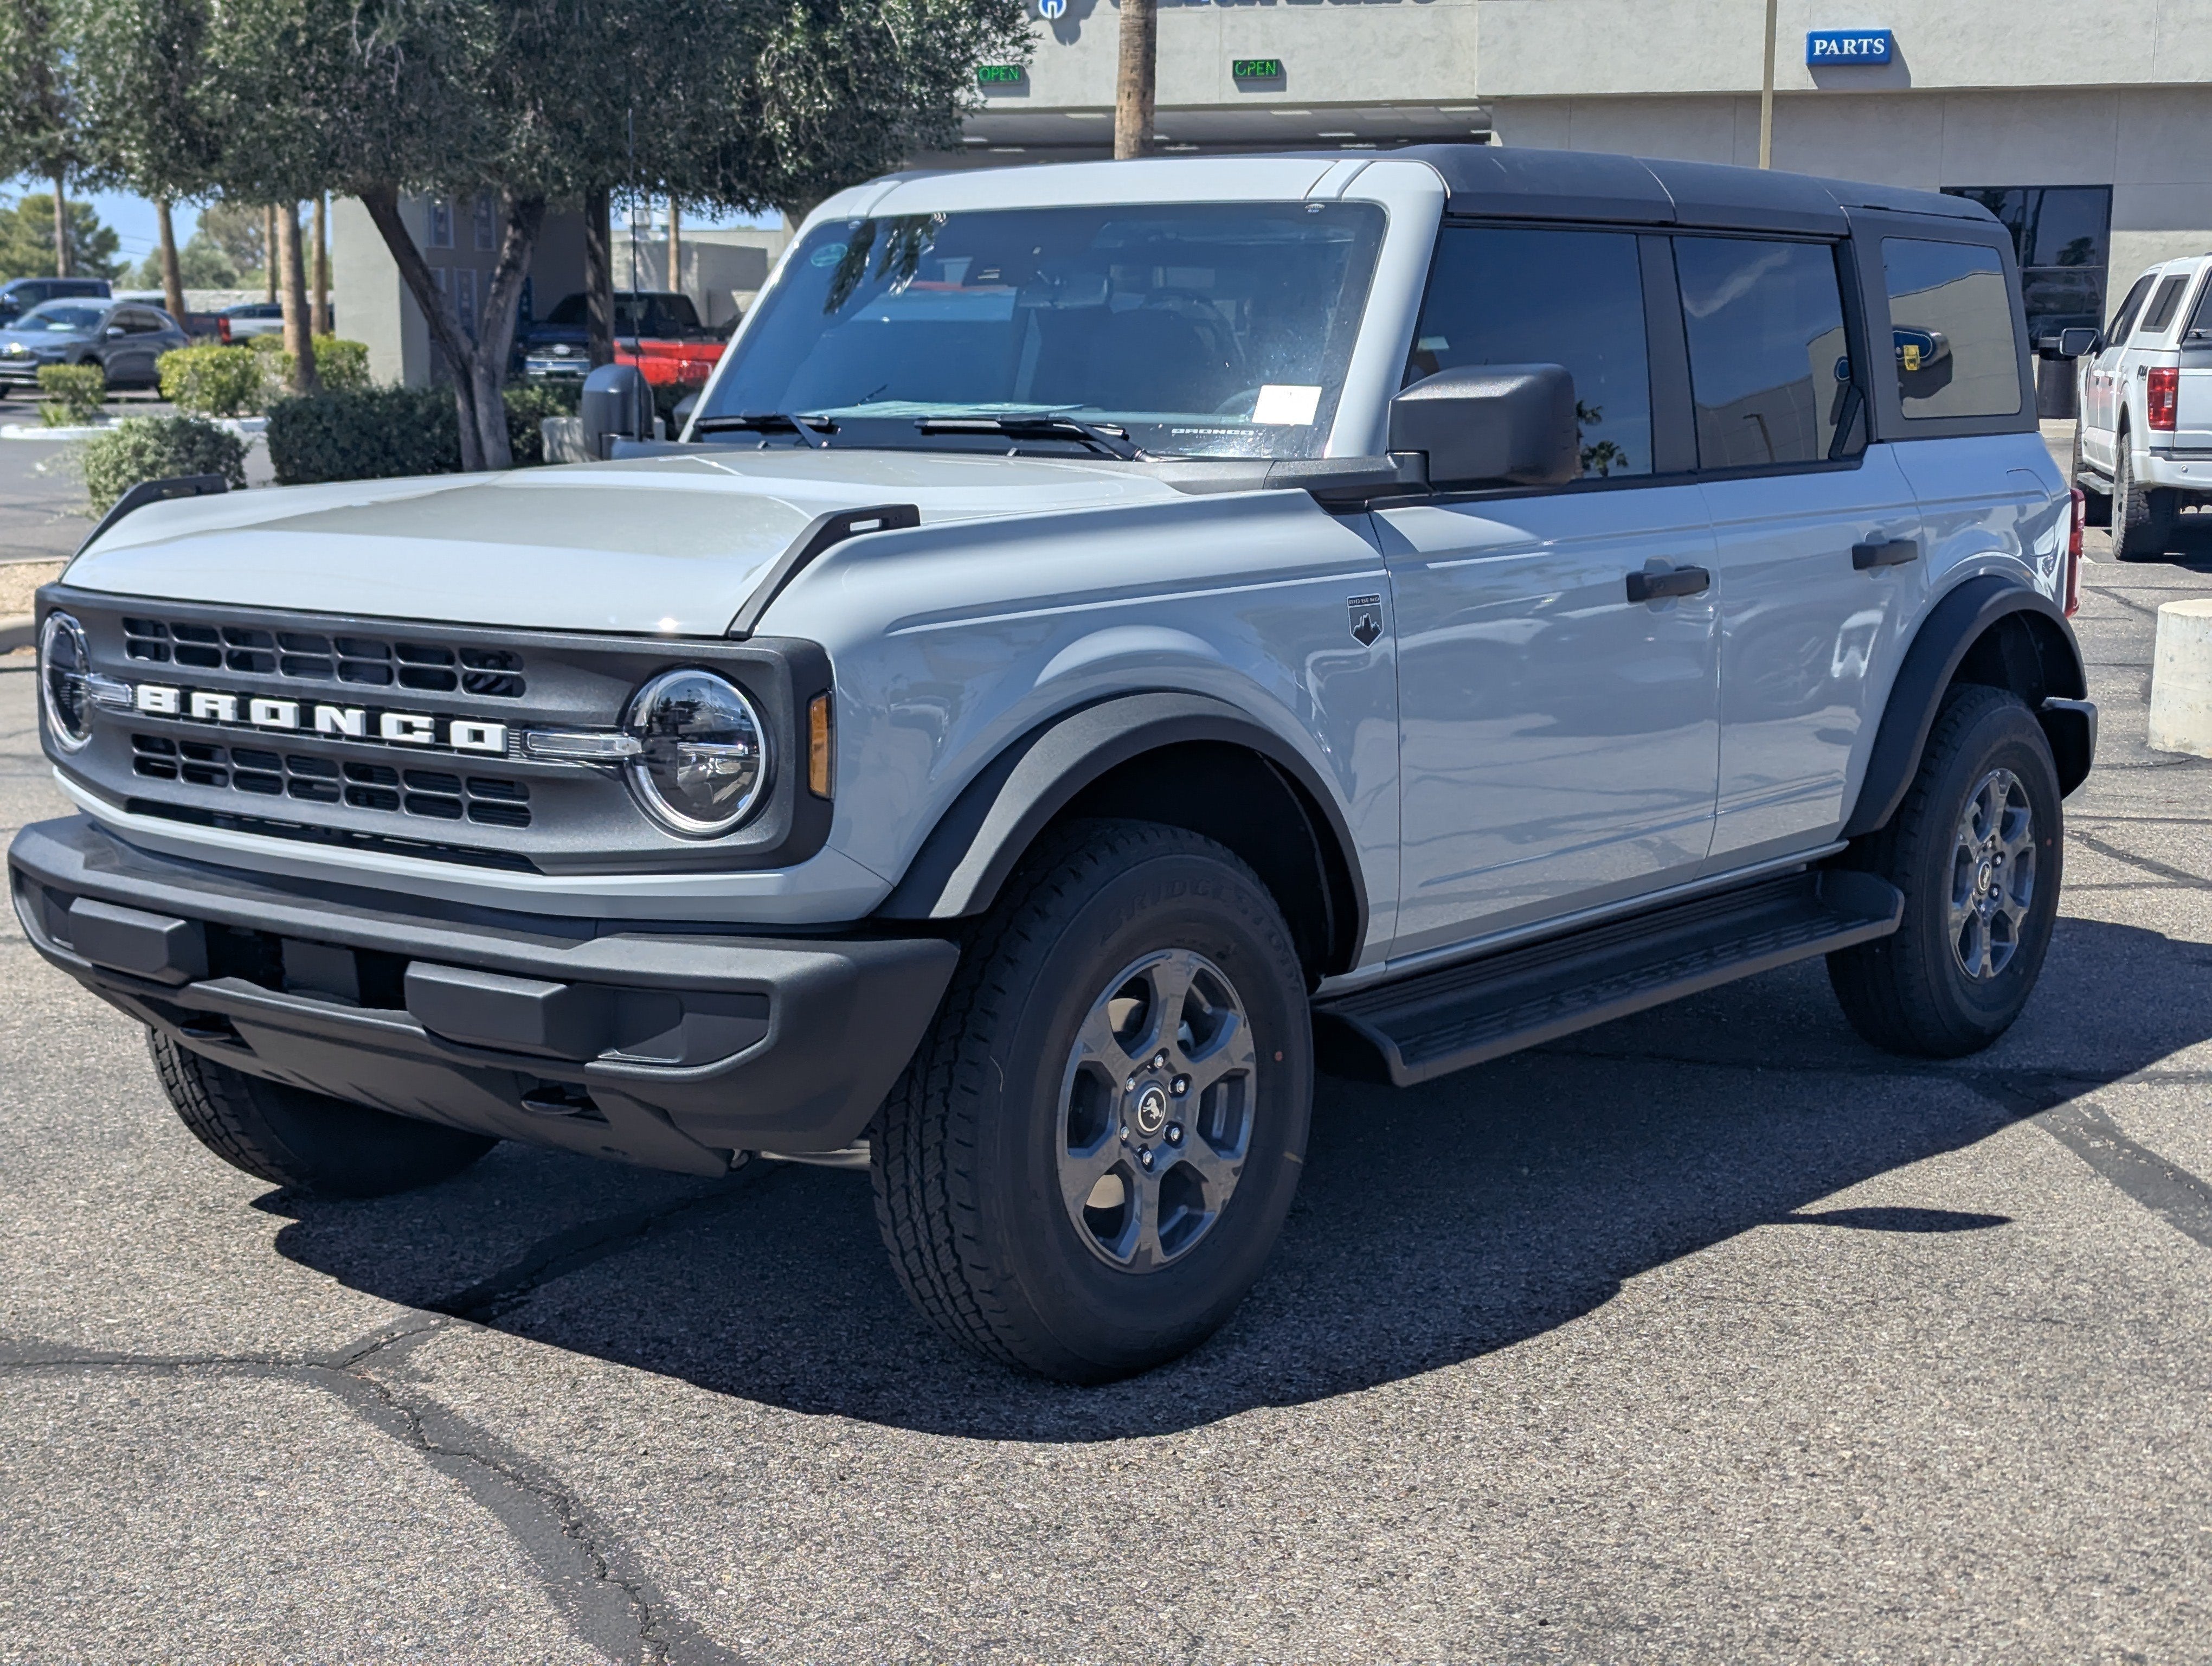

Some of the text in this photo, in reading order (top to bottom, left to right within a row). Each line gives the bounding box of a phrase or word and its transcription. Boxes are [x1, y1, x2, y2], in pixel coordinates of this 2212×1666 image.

[1813, 38, 1885, 56] PARTS
[979, 67, 1019, 81] OPEN
[1235, 61, 1276, 75] OPEN
[137, 684, 508, 753] BRONCO
